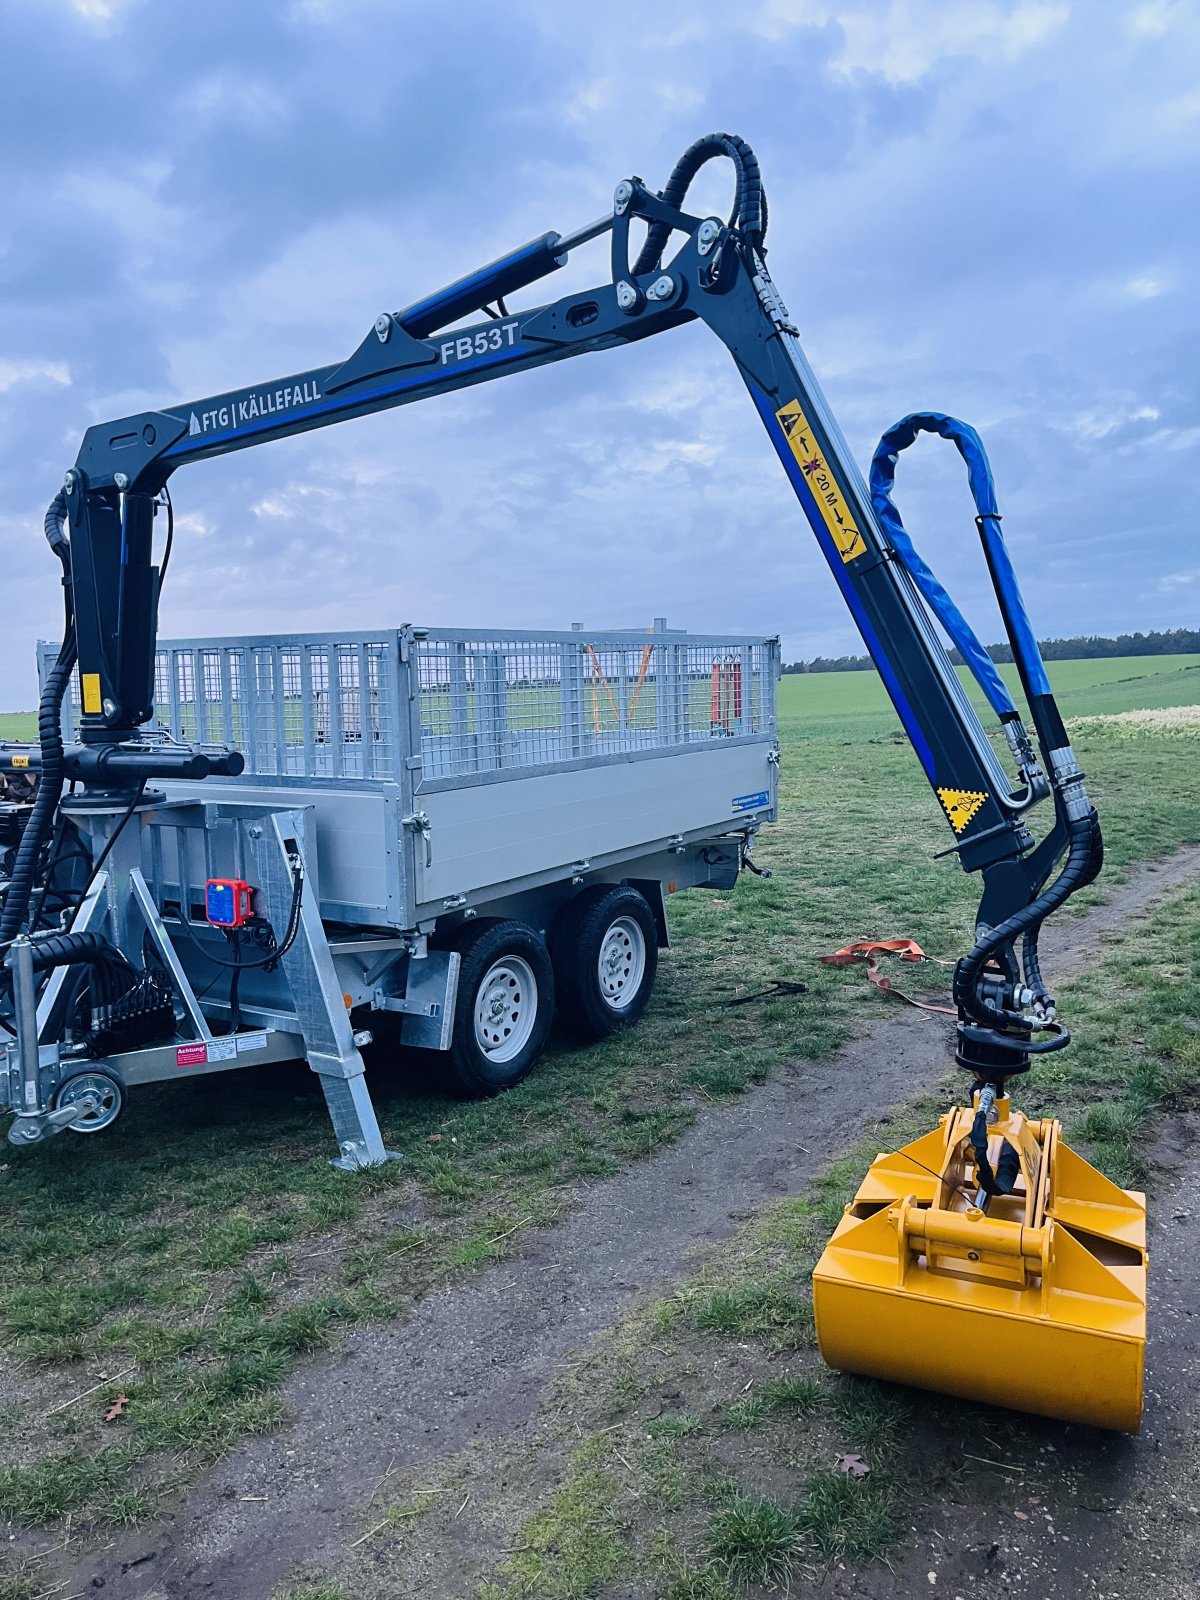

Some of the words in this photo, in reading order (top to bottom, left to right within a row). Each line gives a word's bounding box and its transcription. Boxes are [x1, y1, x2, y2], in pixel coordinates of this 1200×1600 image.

[441, 322, 518, 364] FB53T
[202, 407, 229, 432] FTG
[239, 380, 321, 421] KÄLLEFALL
[816, 474, 830, 491] 20
[825, 492, 838, 506] M
[178, 1046, 205, 1054] Achtung!
